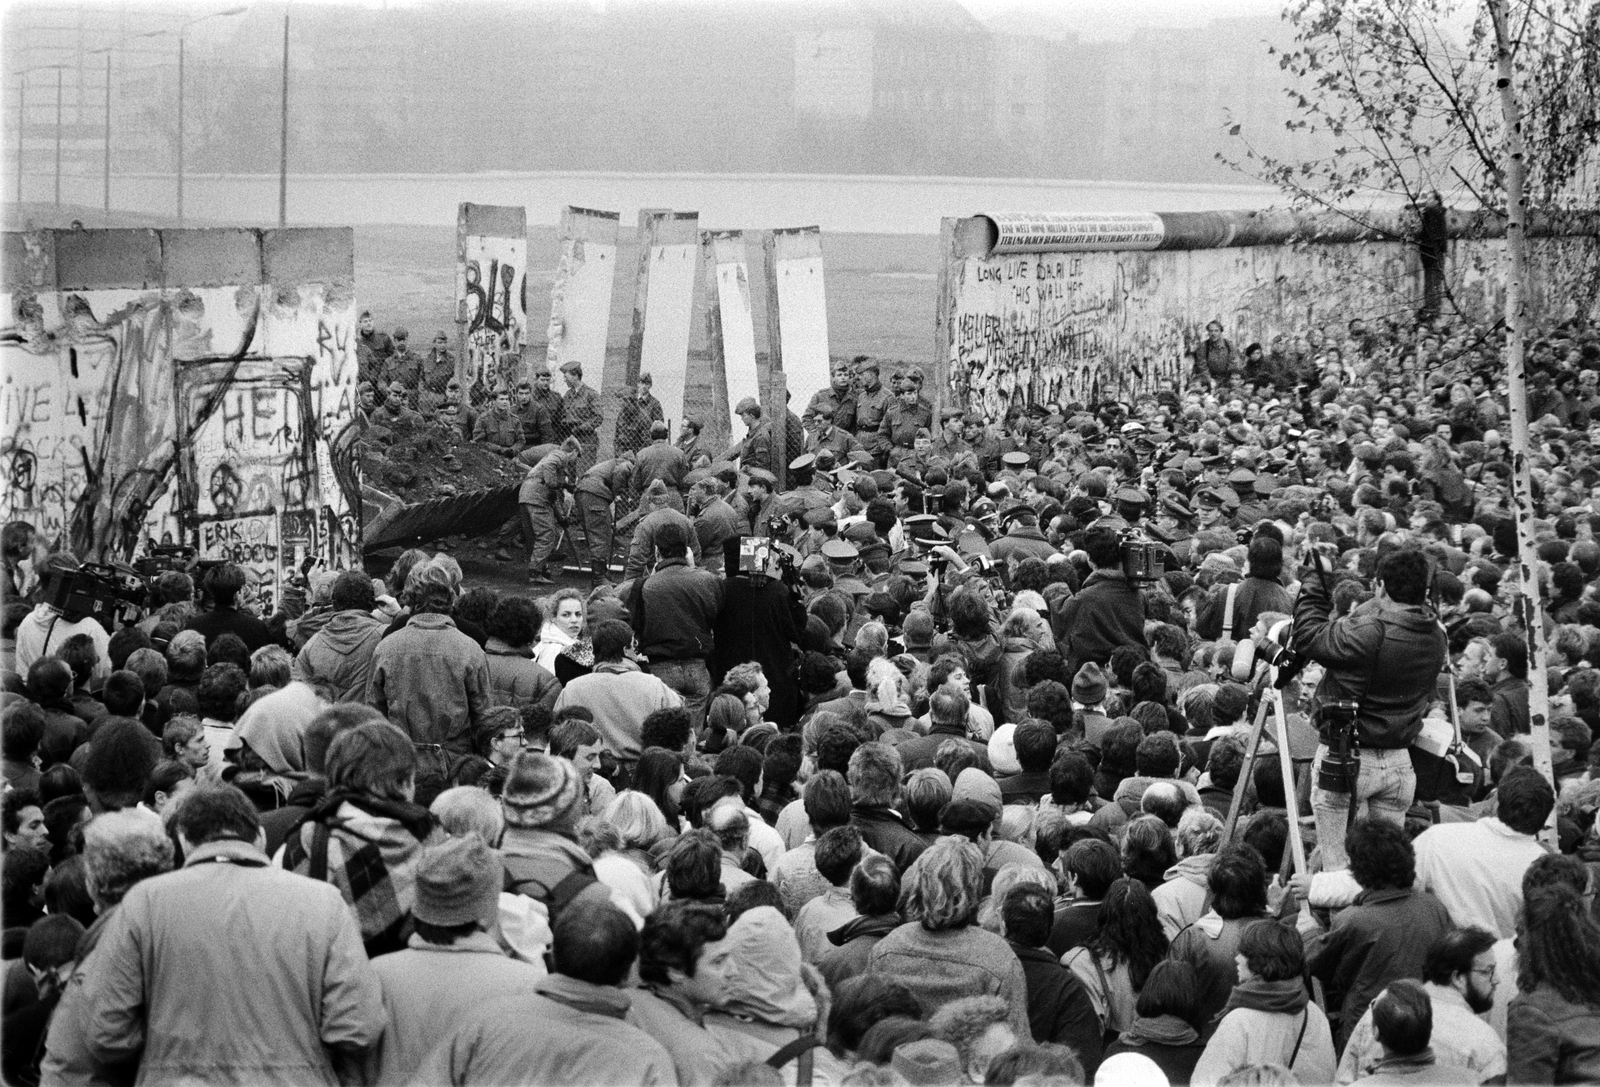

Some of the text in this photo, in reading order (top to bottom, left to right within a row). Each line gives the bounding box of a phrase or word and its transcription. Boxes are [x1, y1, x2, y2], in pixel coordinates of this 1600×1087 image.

[978, 266, 1001, 284] LONG
[1008, 261, 1028, 280] LIVE
[1037, 281, 1063, 301] WALL
[205, 522, 242, 550] ERIK
